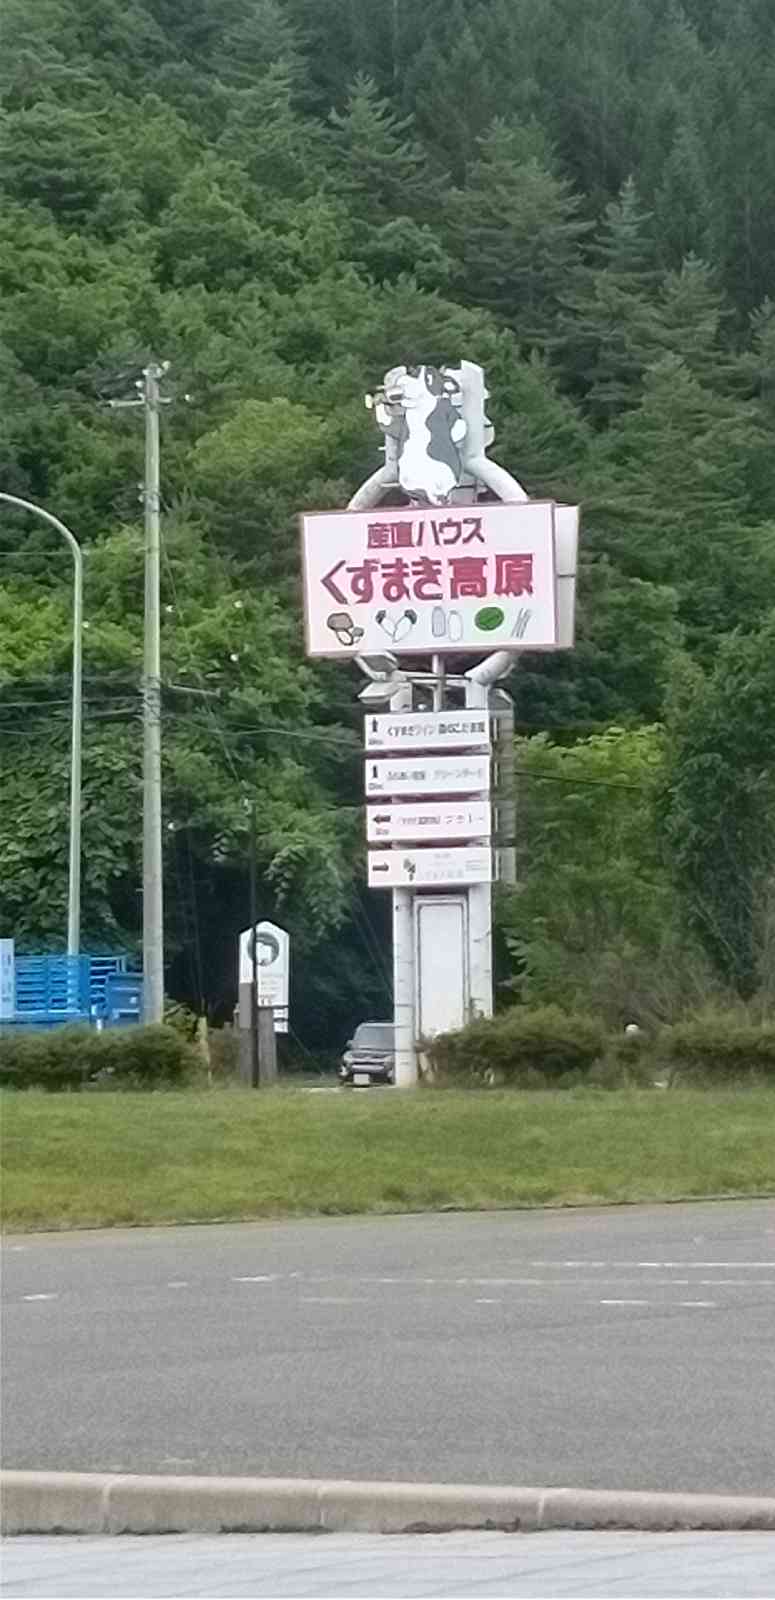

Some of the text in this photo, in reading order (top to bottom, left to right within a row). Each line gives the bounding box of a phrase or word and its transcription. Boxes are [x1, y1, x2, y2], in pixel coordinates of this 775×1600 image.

[367, 517, 485, 549] 産直ハウス
[320, 553, 534, 605] くずまき高原
